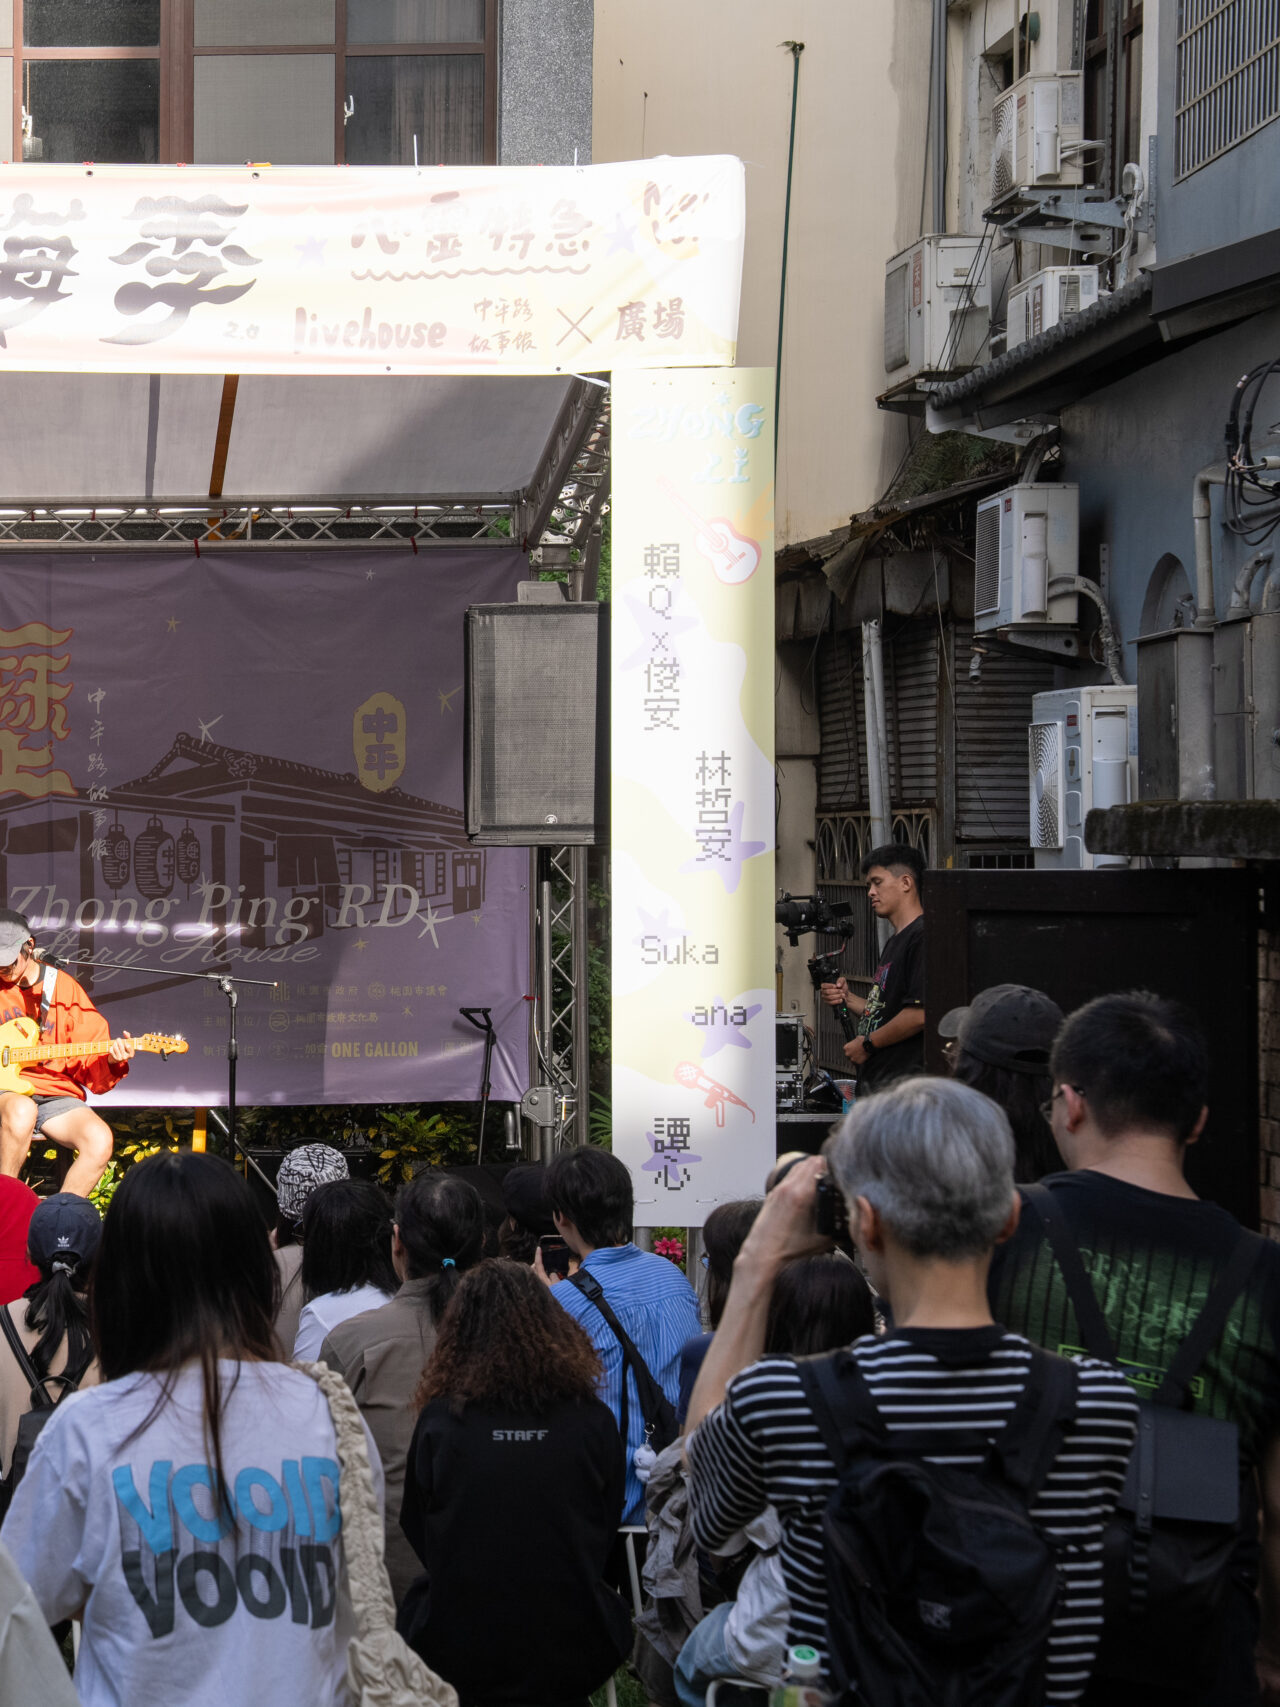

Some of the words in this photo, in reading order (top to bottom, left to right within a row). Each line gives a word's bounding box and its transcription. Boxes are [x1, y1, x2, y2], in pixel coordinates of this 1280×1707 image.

[293, 305, 448, 354] livehouse
[472, 296, 534, 325] 中平路
[615, 296, 686, 342] 廣場
[362, 706, 399, 780] 中平
[696, 750, 731, 861] 林哲安
[8, 884, 180, 944] Zhong
[197, 884, 320, 944] Ping
[330, 884, 422, 928] RD
[160, 927, 321, 964] House
[640, 935, 720, 966] Suka
[690, 1004, 749, 1027] ana
[331, 1041, 361, 1058] ONE
[365, 1041, 419, 1057] GALLON
[654, 1117, 690, 1191] 譚心
[492, 1429, 549, 1442] STAFF
[112, 1456, 341, 1554] VOOID
[121, 1544, 336, 1639] VOOID
